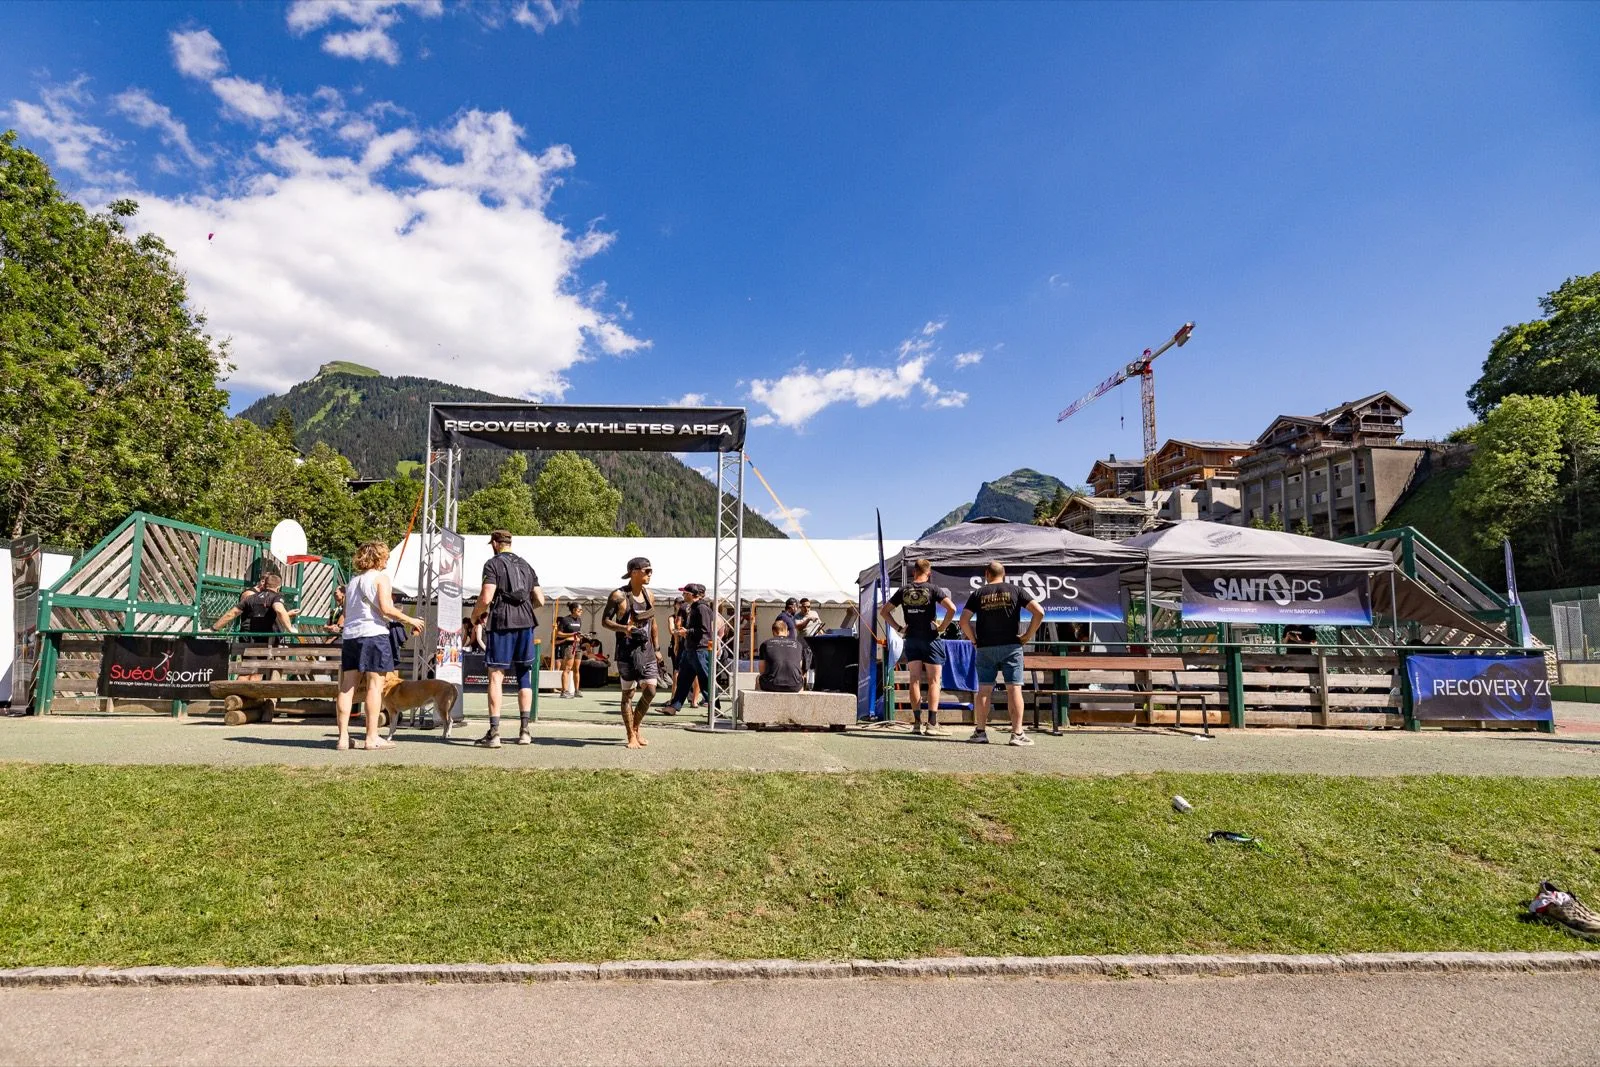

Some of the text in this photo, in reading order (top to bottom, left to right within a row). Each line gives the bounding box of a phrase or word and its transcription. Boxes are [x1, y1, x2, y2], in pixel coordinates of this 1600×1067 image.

[444, 419, 733, 436] RECOVERY & ATHLETES AREA
[1213, 573, 1325, 606] SANTOPS
[1433, 679, 1528, 696] RECOVERY
